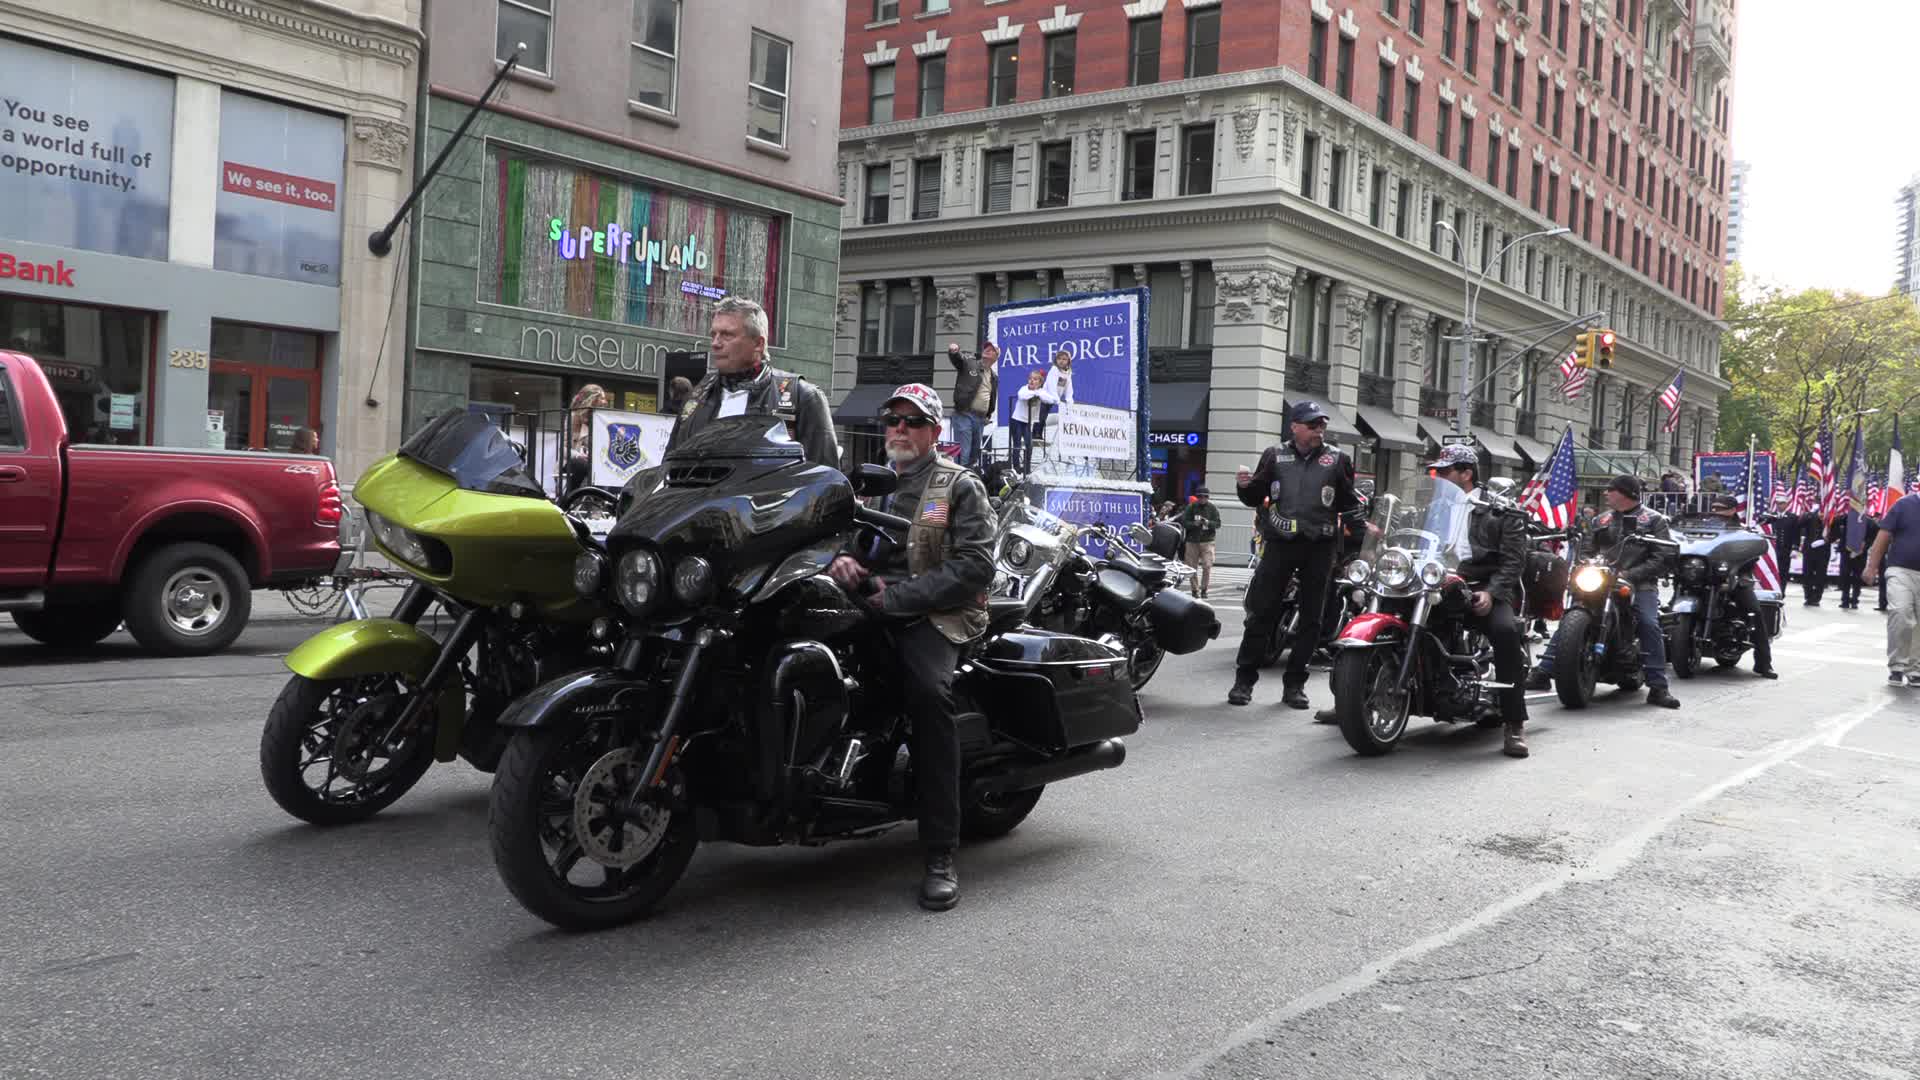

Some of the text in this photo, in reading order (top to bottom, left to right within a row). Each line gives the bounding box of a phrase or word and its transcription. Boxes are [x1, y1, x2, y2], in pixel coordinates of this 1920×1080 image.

[4, 99, 90, 132] You see
[2, 128, 152, 168] a world full of
[1, 153, 136, 193] opportunity.
[227, 170, 333, 204] We see it, too.
[0, 252, 76, 287] Bank
[1002, 313, 1127, 338] SALUTE TO THE U.S.
[168, 350, 208, 369] 235
[1001, 344, 1041, 368] AIR
[1047, 335, 1125, 364] FORCE
[1063, 423, 1127, 440] KEVIN CARRICK
[1148, 433, 1185, 444] CHASE
[1051, 500, 1139, 514] SALUTE TO THE U.S.
